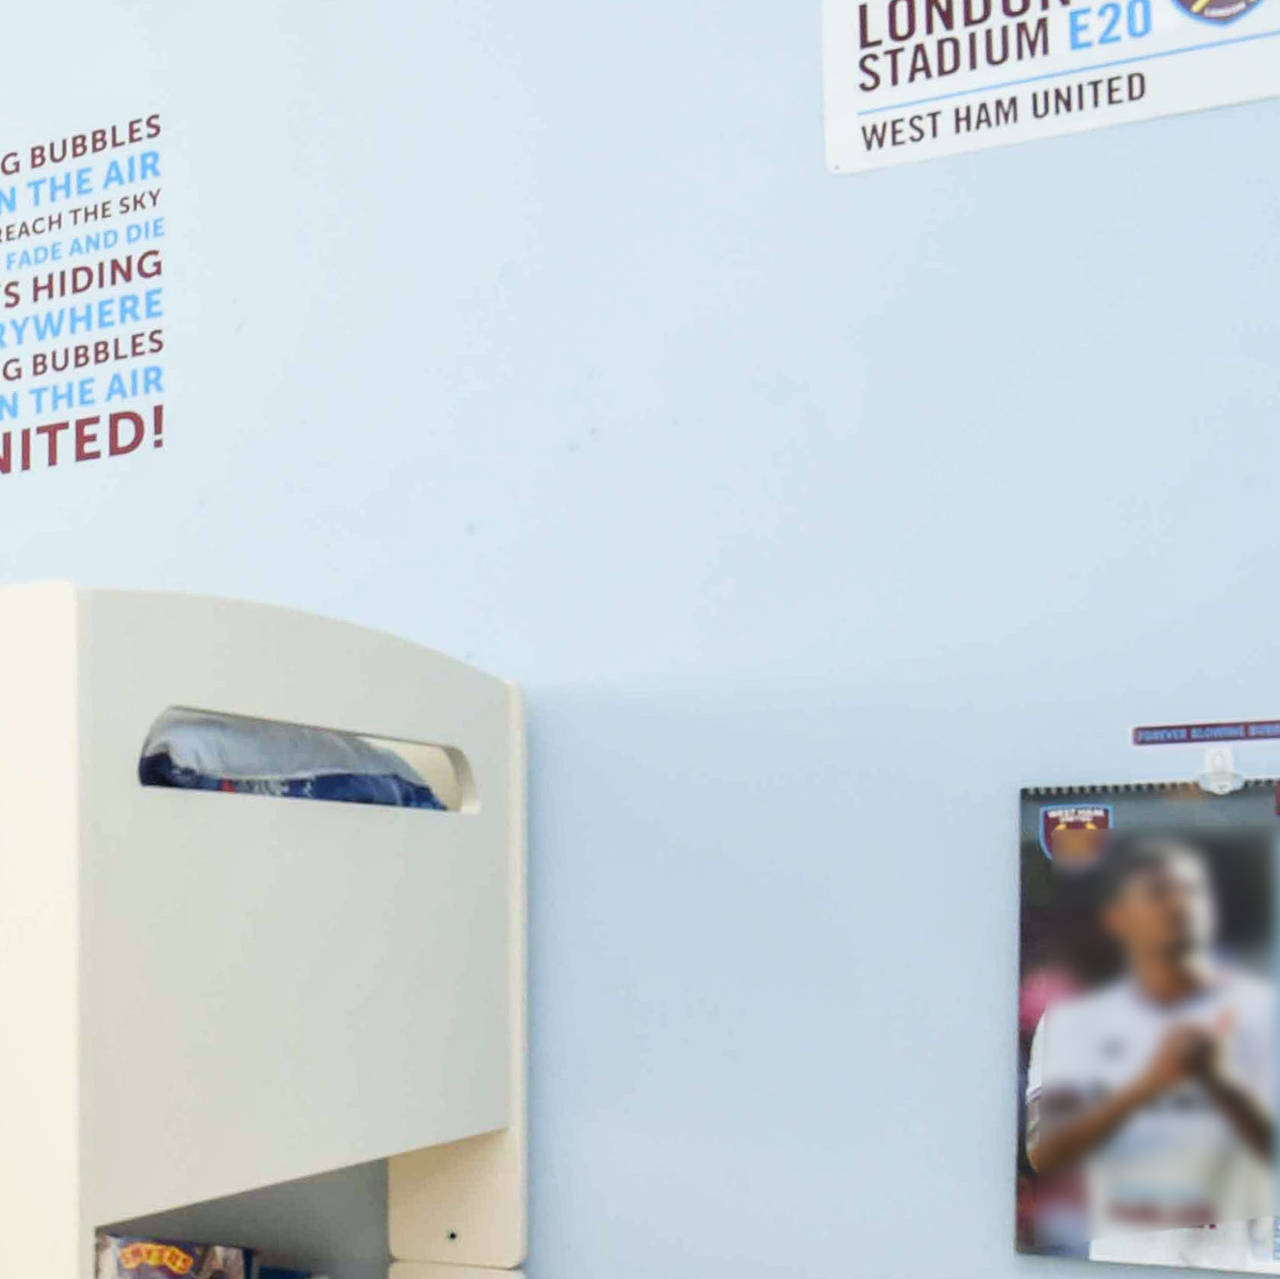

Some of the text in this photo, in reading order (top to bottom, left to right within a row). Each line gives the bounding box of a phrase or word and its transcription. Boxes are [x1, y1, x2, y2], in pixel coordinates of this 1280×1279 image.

[858, 0, 1071, 49] LOND
[858, 0, 1152, 92] STADIUM E20
[860, 72, 1146, 152] WEST HAM UNITED
[30, 114, 161, 170] BUBBLES
[26, 166, 94, 207] THE
[102, 150, 161, 190] AIR
[68, 200, 112, 226] THE
[119, 188, 161, 214] SKY
[6, 242, 62, 270] FADE
[68, 230, 118, 256] AND
[126, 216, 165, 245] DIE
[32, 250, 162, 304] HIDING
[32, 329, 164, 377] BUBBLES
[28, 376, 96, 414] THE
[105, 365, 164, 403] AIR
